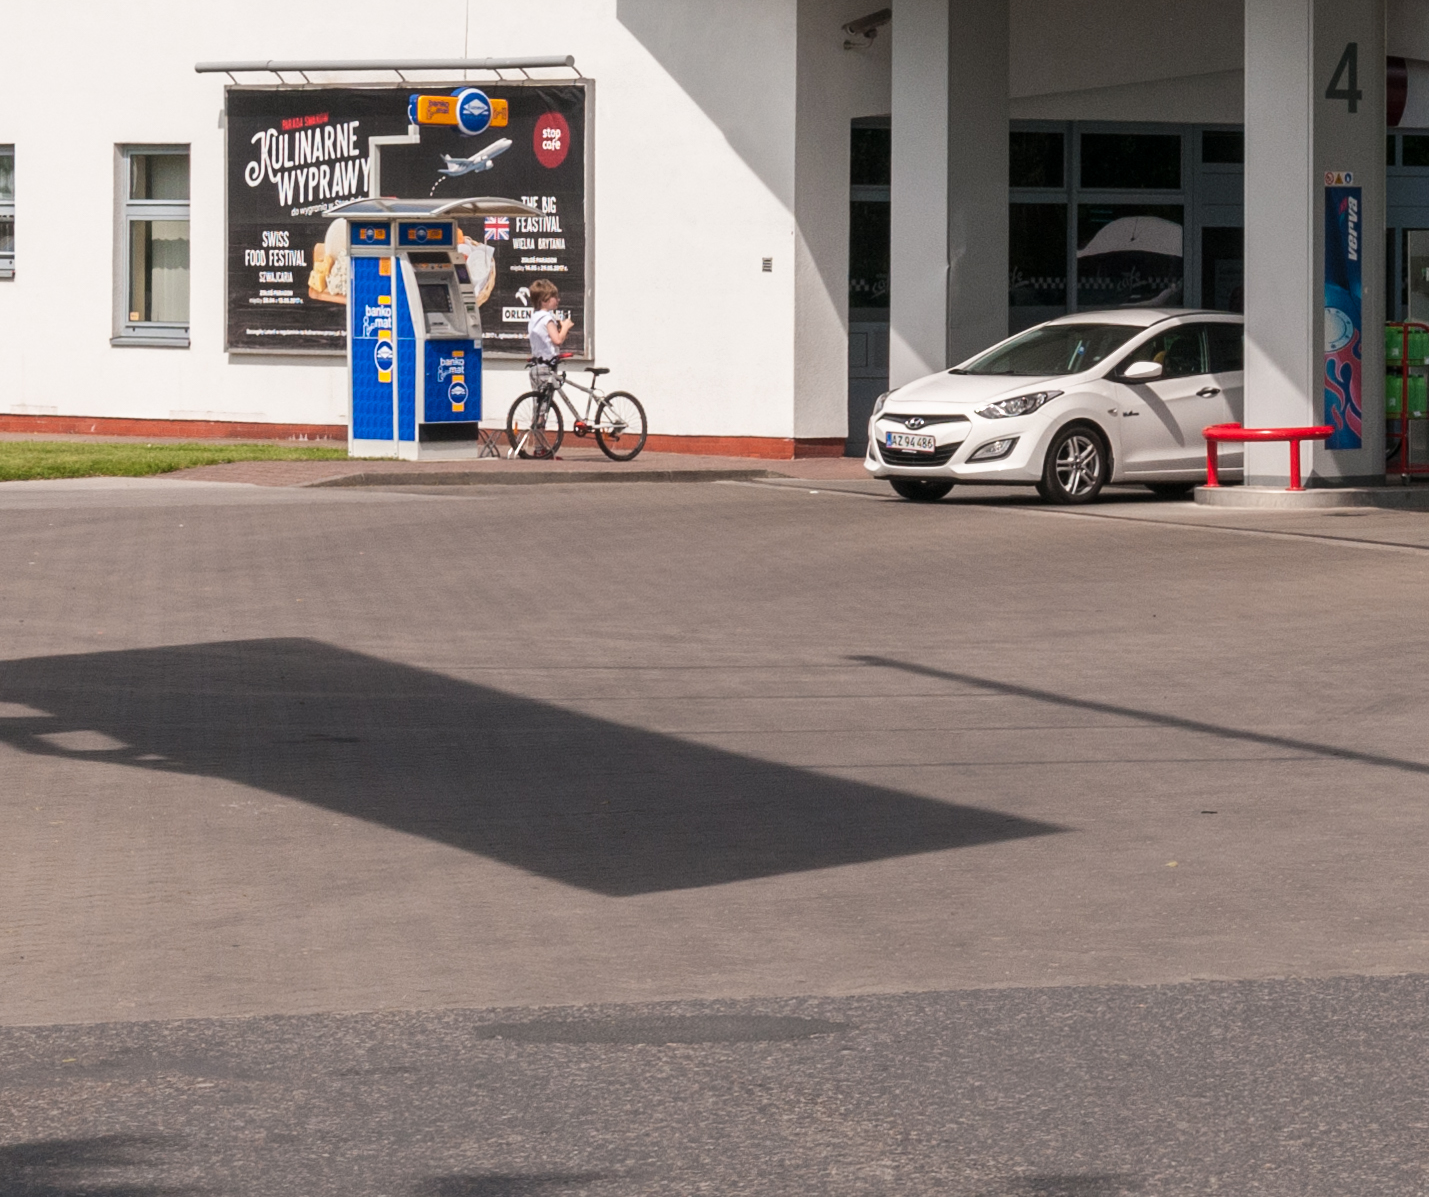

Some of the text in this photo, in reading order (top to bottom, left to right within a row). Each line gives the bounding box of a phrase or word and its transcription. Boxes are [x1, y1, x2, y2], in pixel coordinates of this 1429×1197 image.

[1325, 42, 1362, 113] 4
[542, 128, 561, 141] stop
[542, 139, 561, 151] cafe
[245, 121, 359, 187] KULINARNE
[277, 157, 370, 206] WYPRAWY
[542, 196, 557, 214] BIG
[516, 216, 563, 233] FEASTIVAL
[1347, 196, 1358, 261] verva
[262, 230, 290, 248] SWISS
[245, 250, 308, 267] FOOD FESTIVAL
[366, 305, 391, 316] banko
[504, 309, 531, 319] ORLEN
[375, 317, 391, 328] mat
[440, 357, 464, 366] banko
[893, 435, 903, 446] AZ
